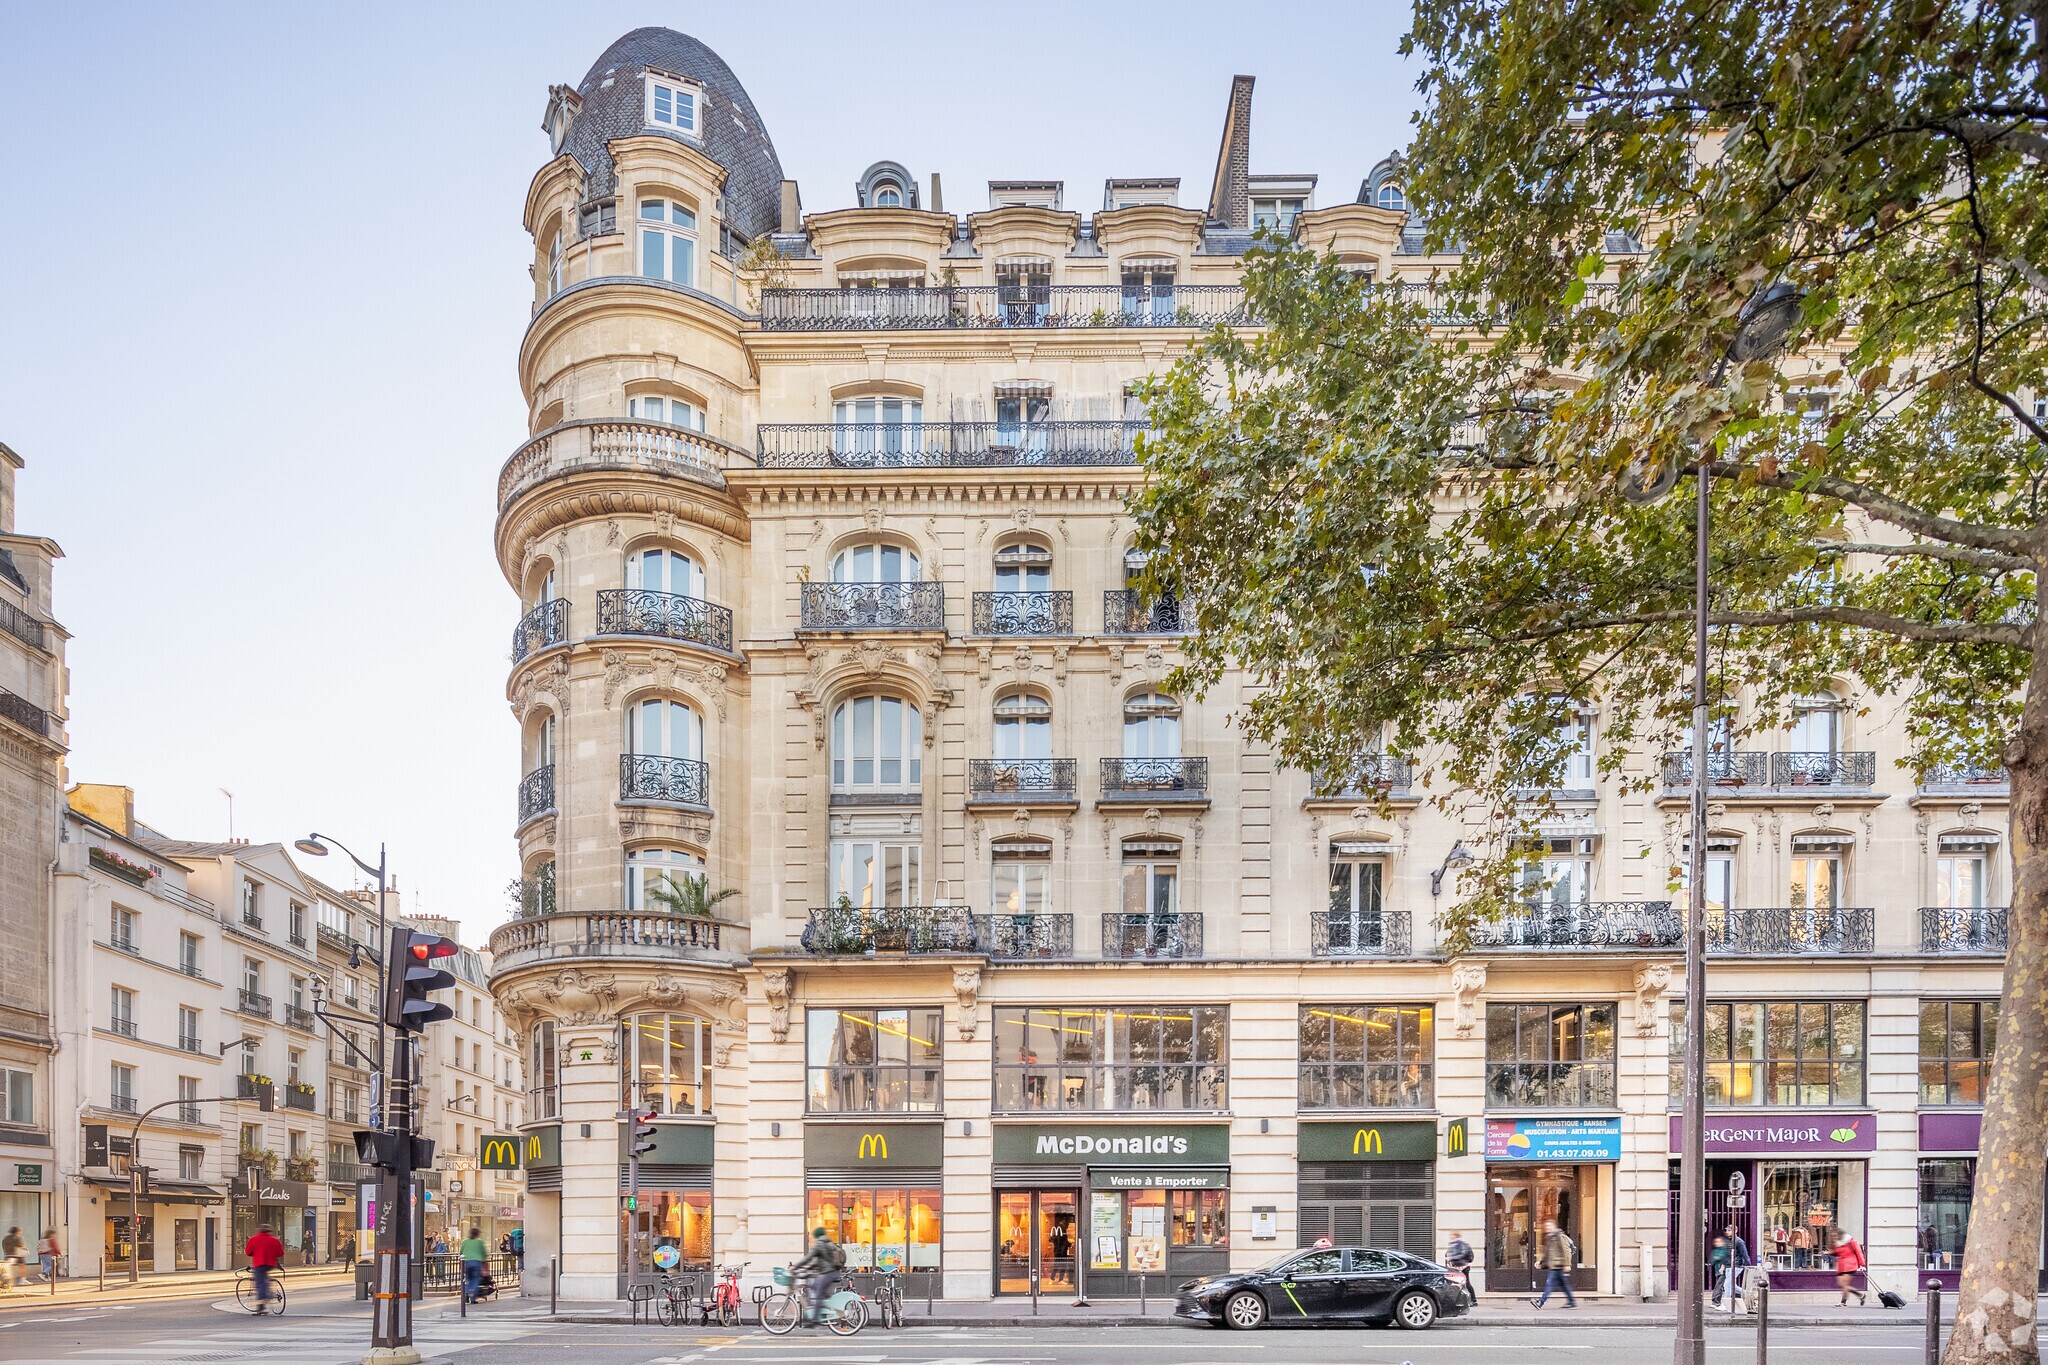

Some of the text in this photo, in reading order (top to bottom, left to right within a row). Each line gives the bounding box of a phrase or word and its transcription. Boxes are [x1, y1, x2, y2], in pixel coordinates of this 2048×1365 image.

[1036, 1136, 1188, 1154] McDonald's
[1537, 1150, 1608, 1158] 01.43.07.09.09
[446, 1162, 475, 1170] RINCK
[1110, 1176, 1208, 1188] Vente à Emporter
[260, 1187, 290, 1200] Clarks
